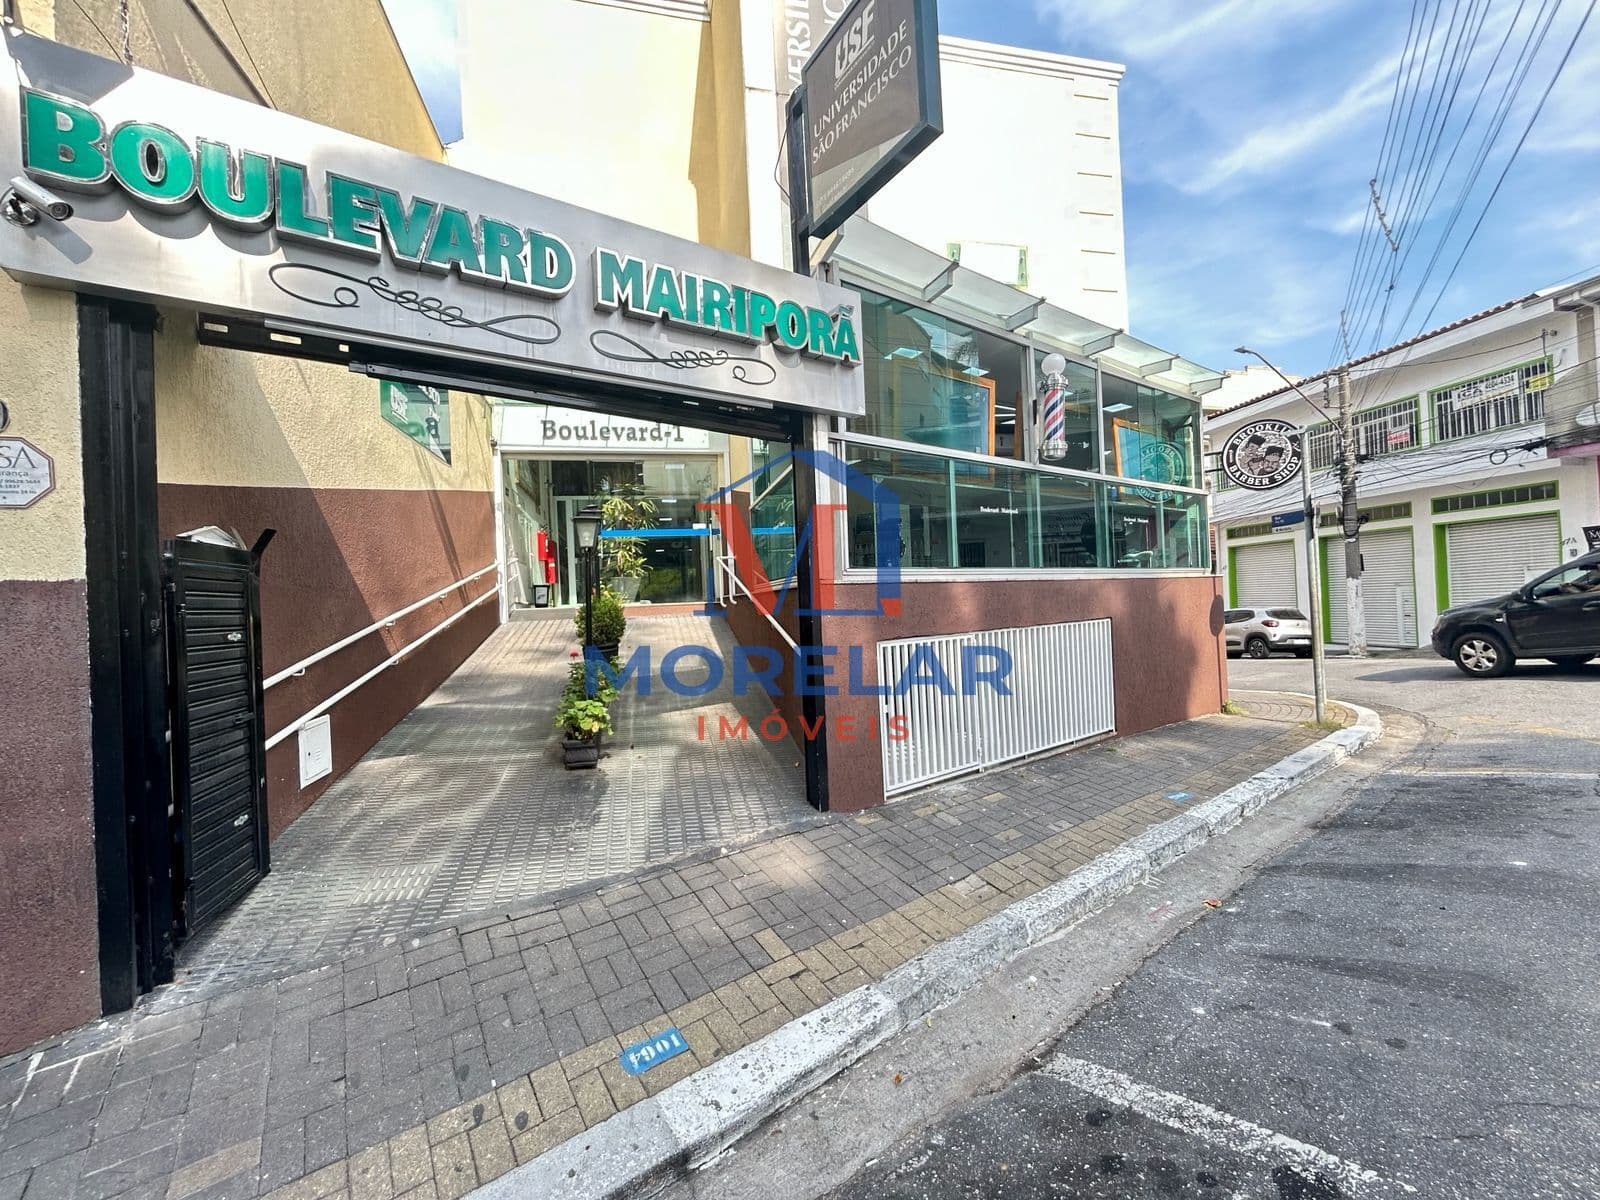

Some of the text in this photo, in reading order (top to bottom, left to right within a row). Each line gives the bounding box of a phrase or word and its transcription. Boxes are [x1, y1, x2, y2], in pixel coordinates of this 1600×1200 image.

[812, 130, 835, 164] SÃO
[835, 45, 912, 139] FRANCISCO
[813, 19, 907, 138] UNIVERSIDADE
[22, 87, 863, 368] BOULEVARD MAIRIPORÃ
[1229, 464, 1270, 486] BARBER
[1274, 456, 1299, 482] SHOP
